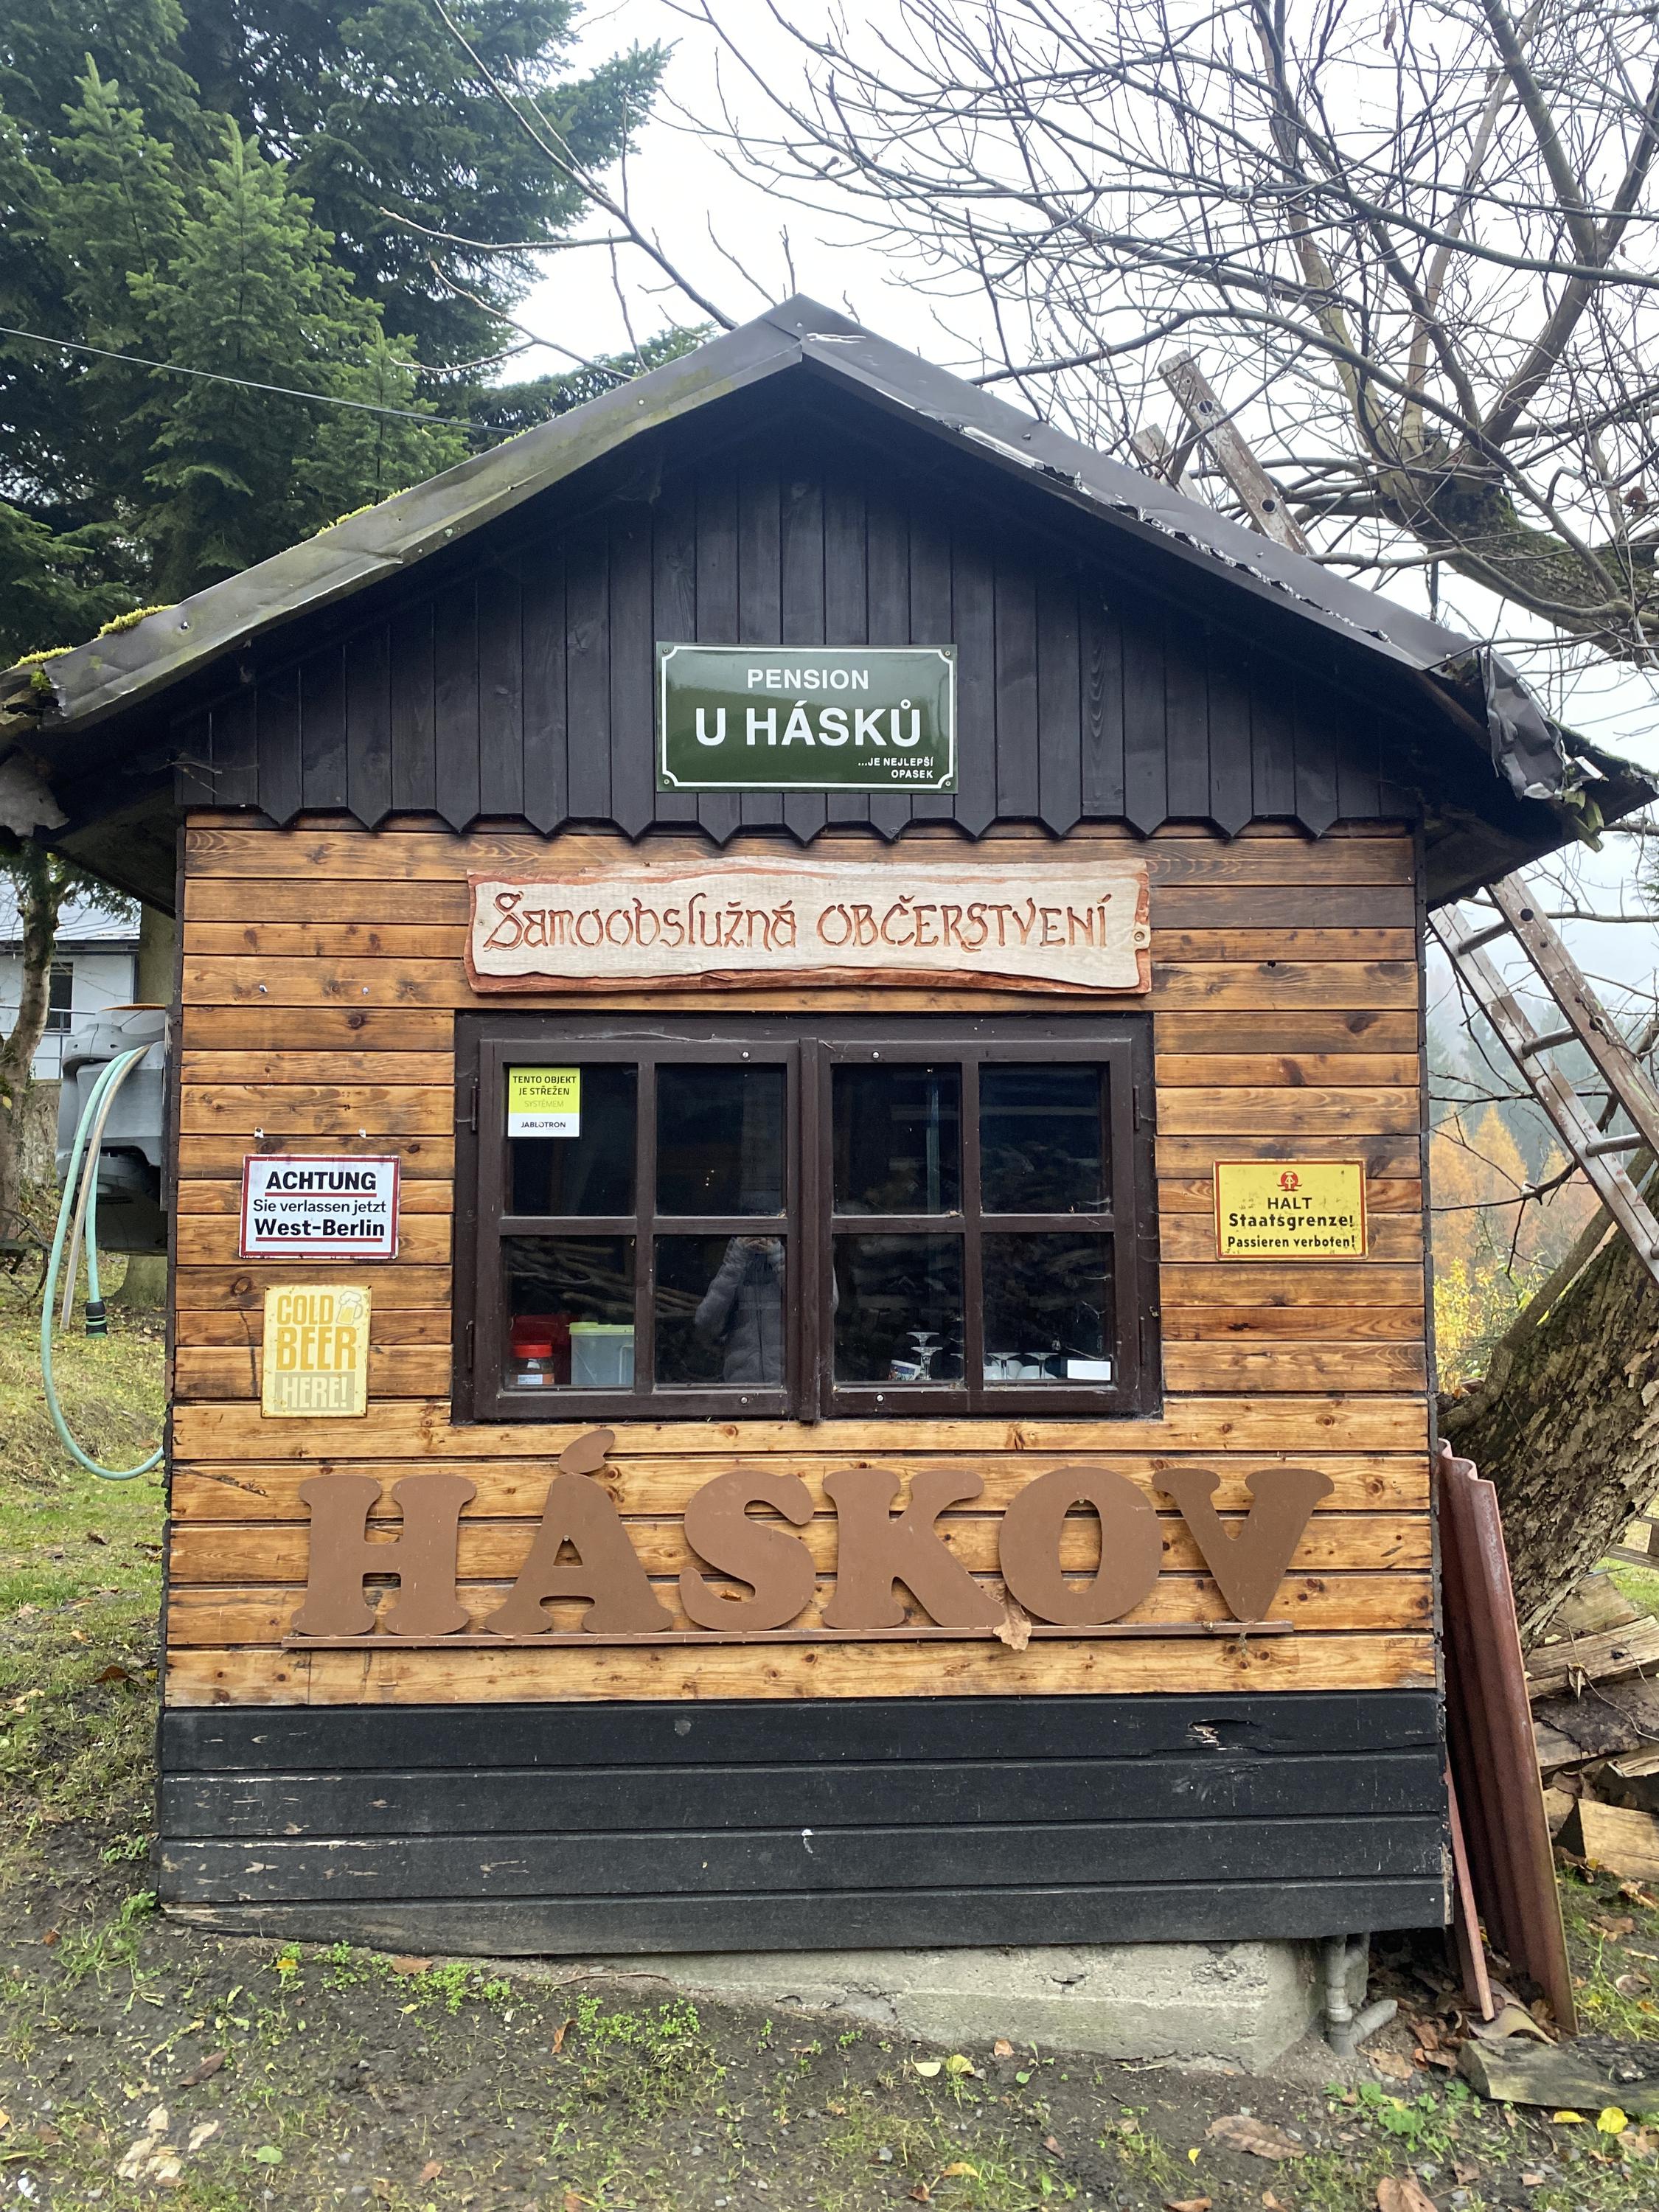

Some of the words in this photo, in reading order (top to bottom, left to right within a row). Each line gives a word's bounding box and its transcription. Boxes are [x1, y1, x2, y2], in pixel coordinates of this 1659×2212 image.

[747, 669, 869, 689] PENSION
[695, 707, 726, 746] U
[746, 699, 921, 747] HÁSKŮ
[883, 756, 933, 767] NEJLEPŠÍ
[891, 769, 933, 779] OPASEK
[482, 891, 797, 952] Samoobslužná
[816, 894, 1112, 953] OBČERSTVENÍ
[512, 1076, 542, 1084] TENTO
[544, 1076, 577, 1085] OBJEKT
[518, 1088, 528, 1096] JE
[529, 1085, 570, 1096] STŘEŽEN
[265, 1171, 377, 1190] ACHTUNG
[253, 1199, 276, 1211] Sie
[280, 1200, 350, 1213] verlassen
[352, 1200, 386, 1215] jetzt
[1267, 1197, 1312, 1209] HALT
[254, 1218, 385, 1237] West-Berlin
[1229, 1213, 1354, 1231] Staatsgrenze!
[1228, 1235, 1290, 1248] Passieren
[1293, 1234, 1355, 1248] verboten!
[276, 1295, 334, 1326] COLD
[276, 1326, 357, 1371] BEER
[282, 1377, 348, 1408] HERE!
[292, 1427, 1335, 1637] HÁSKOV
